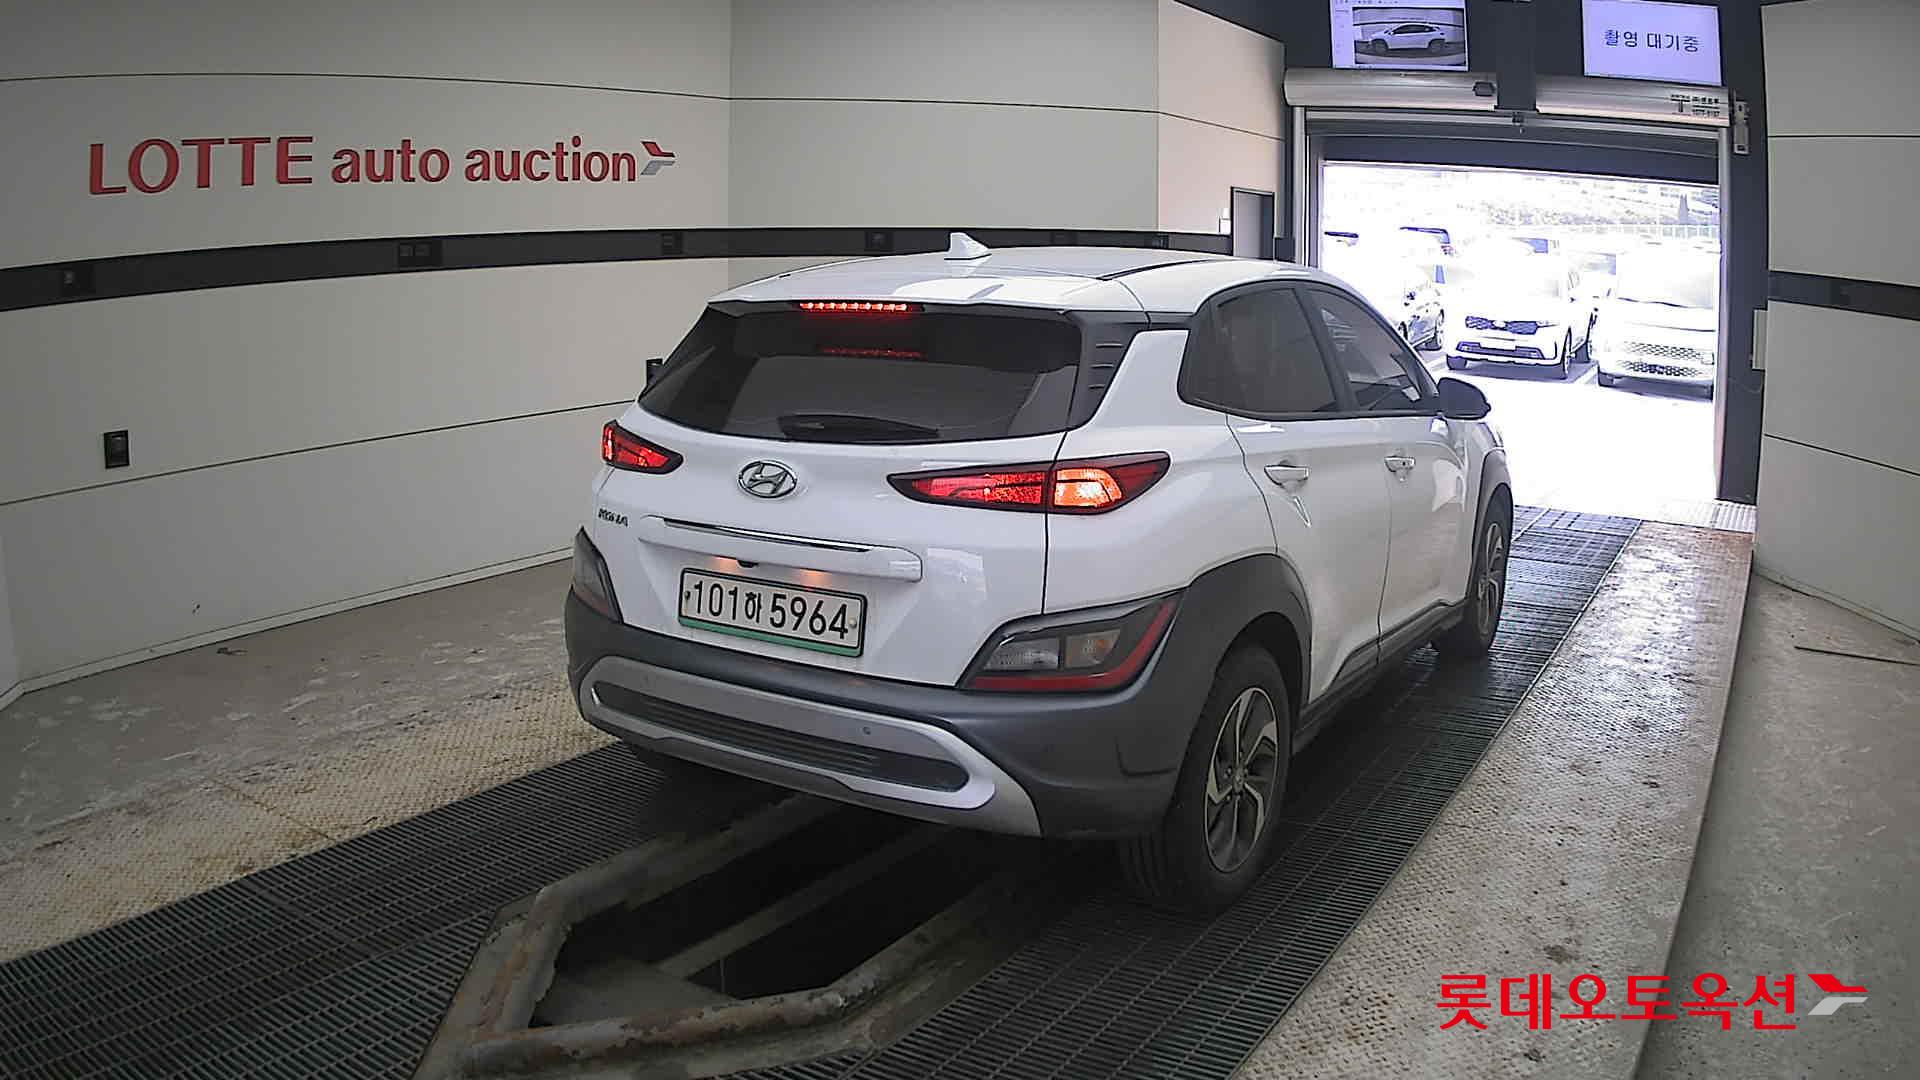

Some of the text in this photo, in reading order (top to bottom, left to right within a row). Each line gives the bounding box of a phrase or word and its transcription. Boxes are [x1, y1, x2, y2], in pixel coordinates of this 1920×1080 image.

[1605, 29, 1699, 53] 촬영 대기중
[89, 136, 637, 196] LOTTE auto auction
